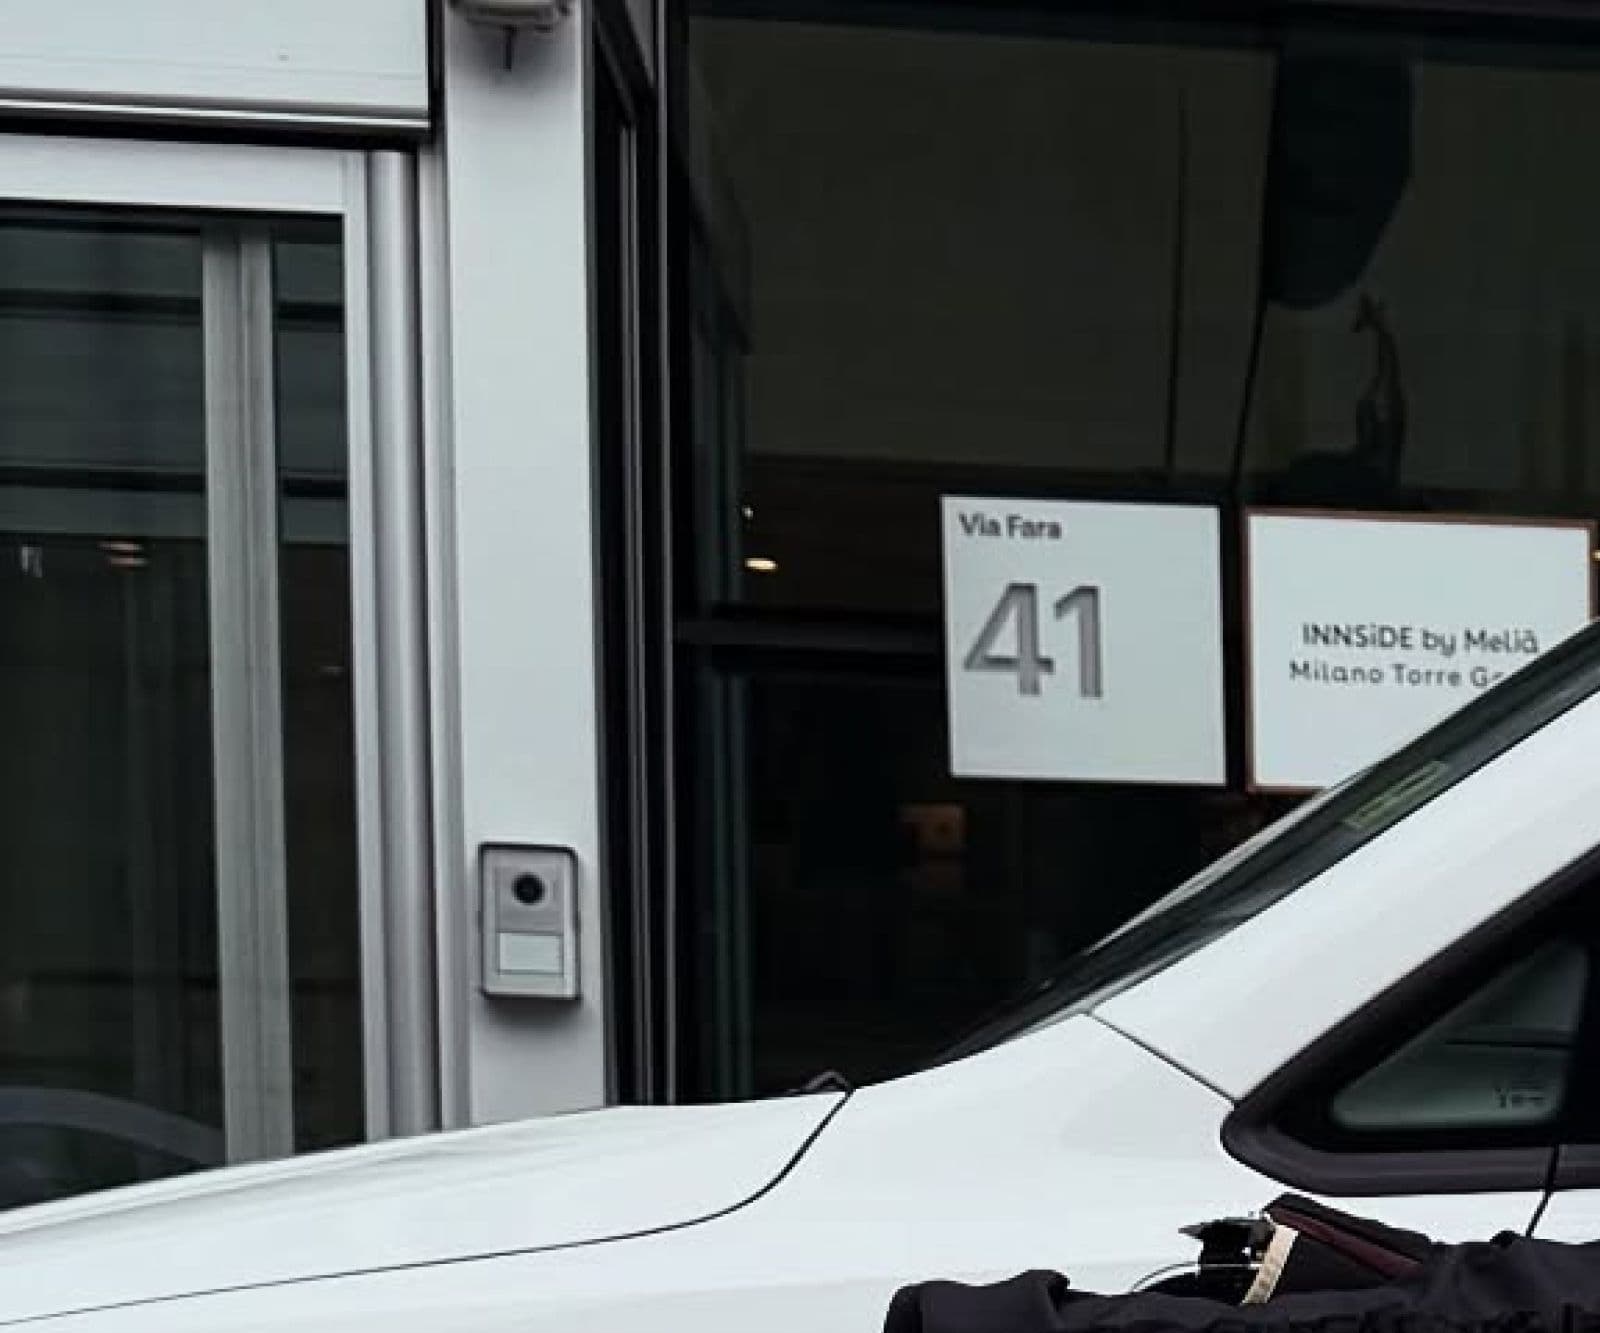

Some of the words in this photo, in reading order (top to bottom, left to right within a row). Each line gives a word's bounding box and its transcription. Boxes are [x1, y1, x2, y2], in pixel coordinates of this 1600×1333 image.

[958, 512, 1001, 537] Via
[1006, 513, 1062, 540] Fara
[962, 581, 1104, 700] 41
[1422, 628, 1457, 658] by
[1289, 659, 1384, 685] Milano
[1391, 662, 1463, 687] Torre
